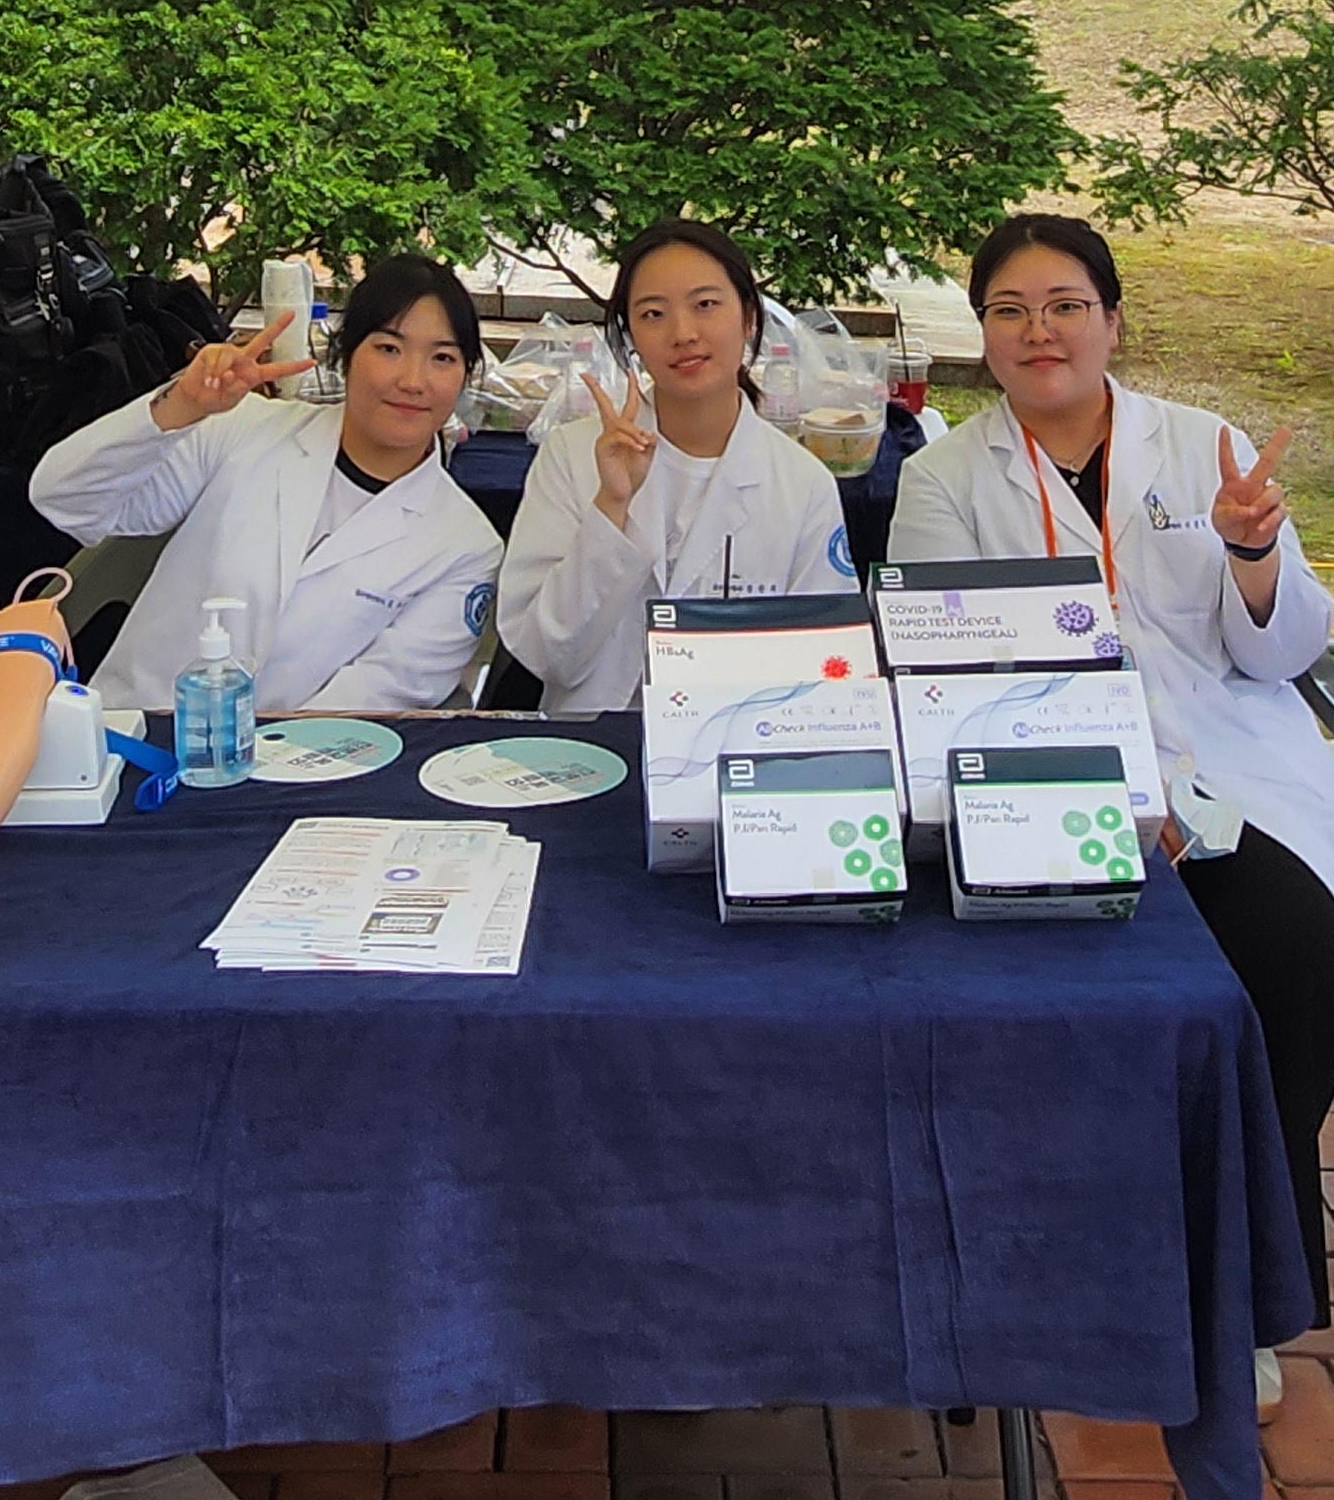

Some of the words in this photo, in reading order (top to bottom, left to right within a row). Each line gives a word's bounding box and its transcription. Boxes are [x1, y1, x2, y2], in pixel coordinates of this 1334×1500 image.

[886, 604, 943, 615] COVID-19
[888, 616, 927, 628] RAPID
[928, 616, 955, 627] TEST
[958, 615, 1002, 627] DEVICE
[890, 628, 1019, 641] (NASOPHARYNGEAL)
[807, 721, 858, 732] Influenza
[859, 720, 882, 731] A+B
[1064, 722, 1115, 733] Influenza
[1116, 722, 1139, 732] A+B
[964, 801, 998, 810] Malaria
[1000, 801, 1014, 812] Ag
[732, 810, 767, 820] Malaria
[768, 809, 782, 821] Ag
[1003, 814, 1030, 826] Rapid
[770, 823, 798, 835] Rapid
